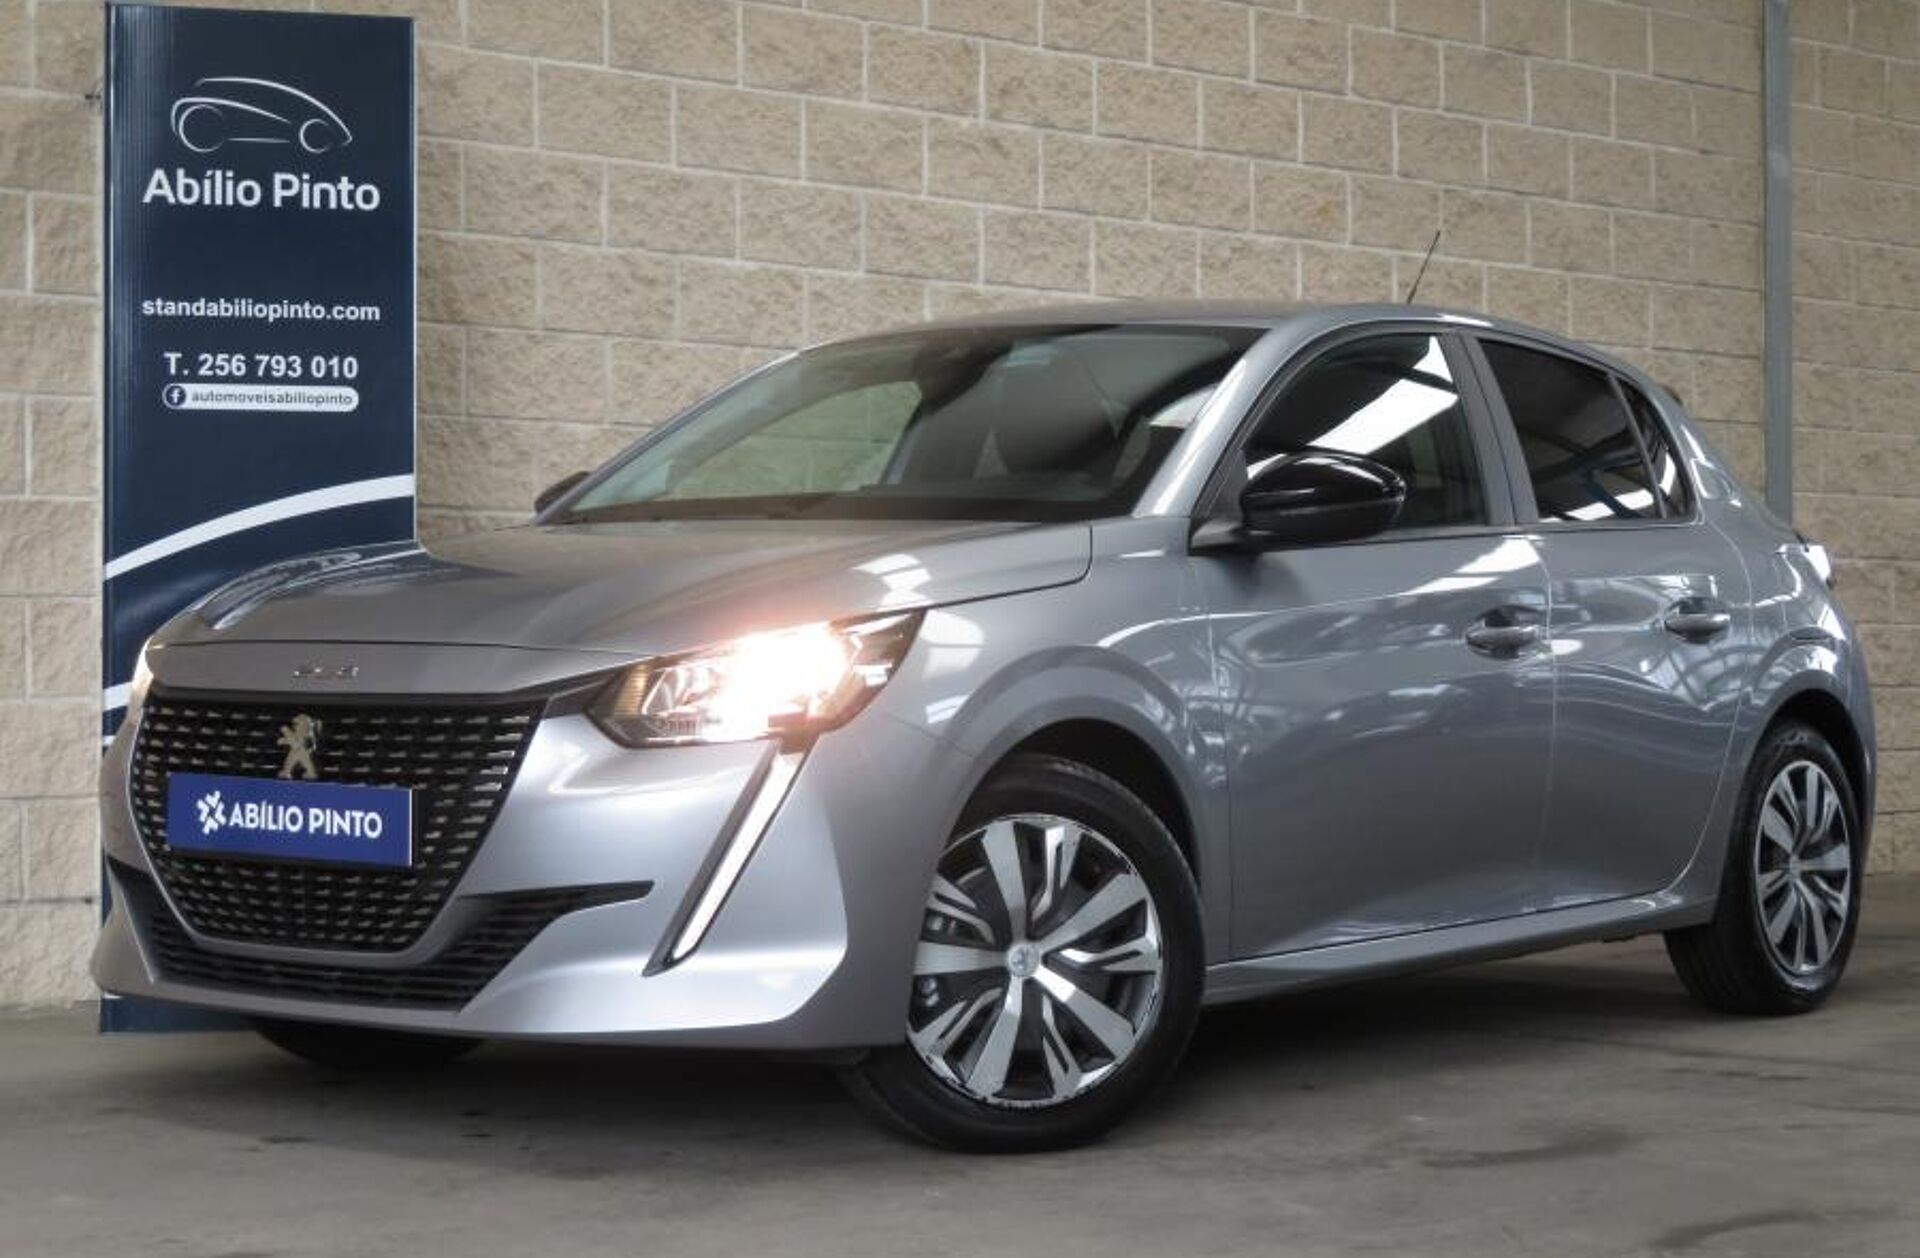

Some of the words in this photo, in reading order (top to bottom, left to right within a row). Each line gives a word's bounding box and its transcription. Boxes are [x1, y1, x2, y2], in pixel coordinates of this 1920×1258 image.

[142, 168, 262, 207] Abílio
[273, 172, 381, 211] Pinto
[142, 298, 381, 322] standabiliopinto.com
[164, 353, 190, 376] T.
[198, 354, 247, 377] 256
[255, 355, 303, 378] 793
[310, 356, 359, 379] 010
[191, 390, 353, 407] automoveisabiliopinto
[229, 801, 303, 832] ABÍLIO
[309, 808, 383, 839] PINTO
